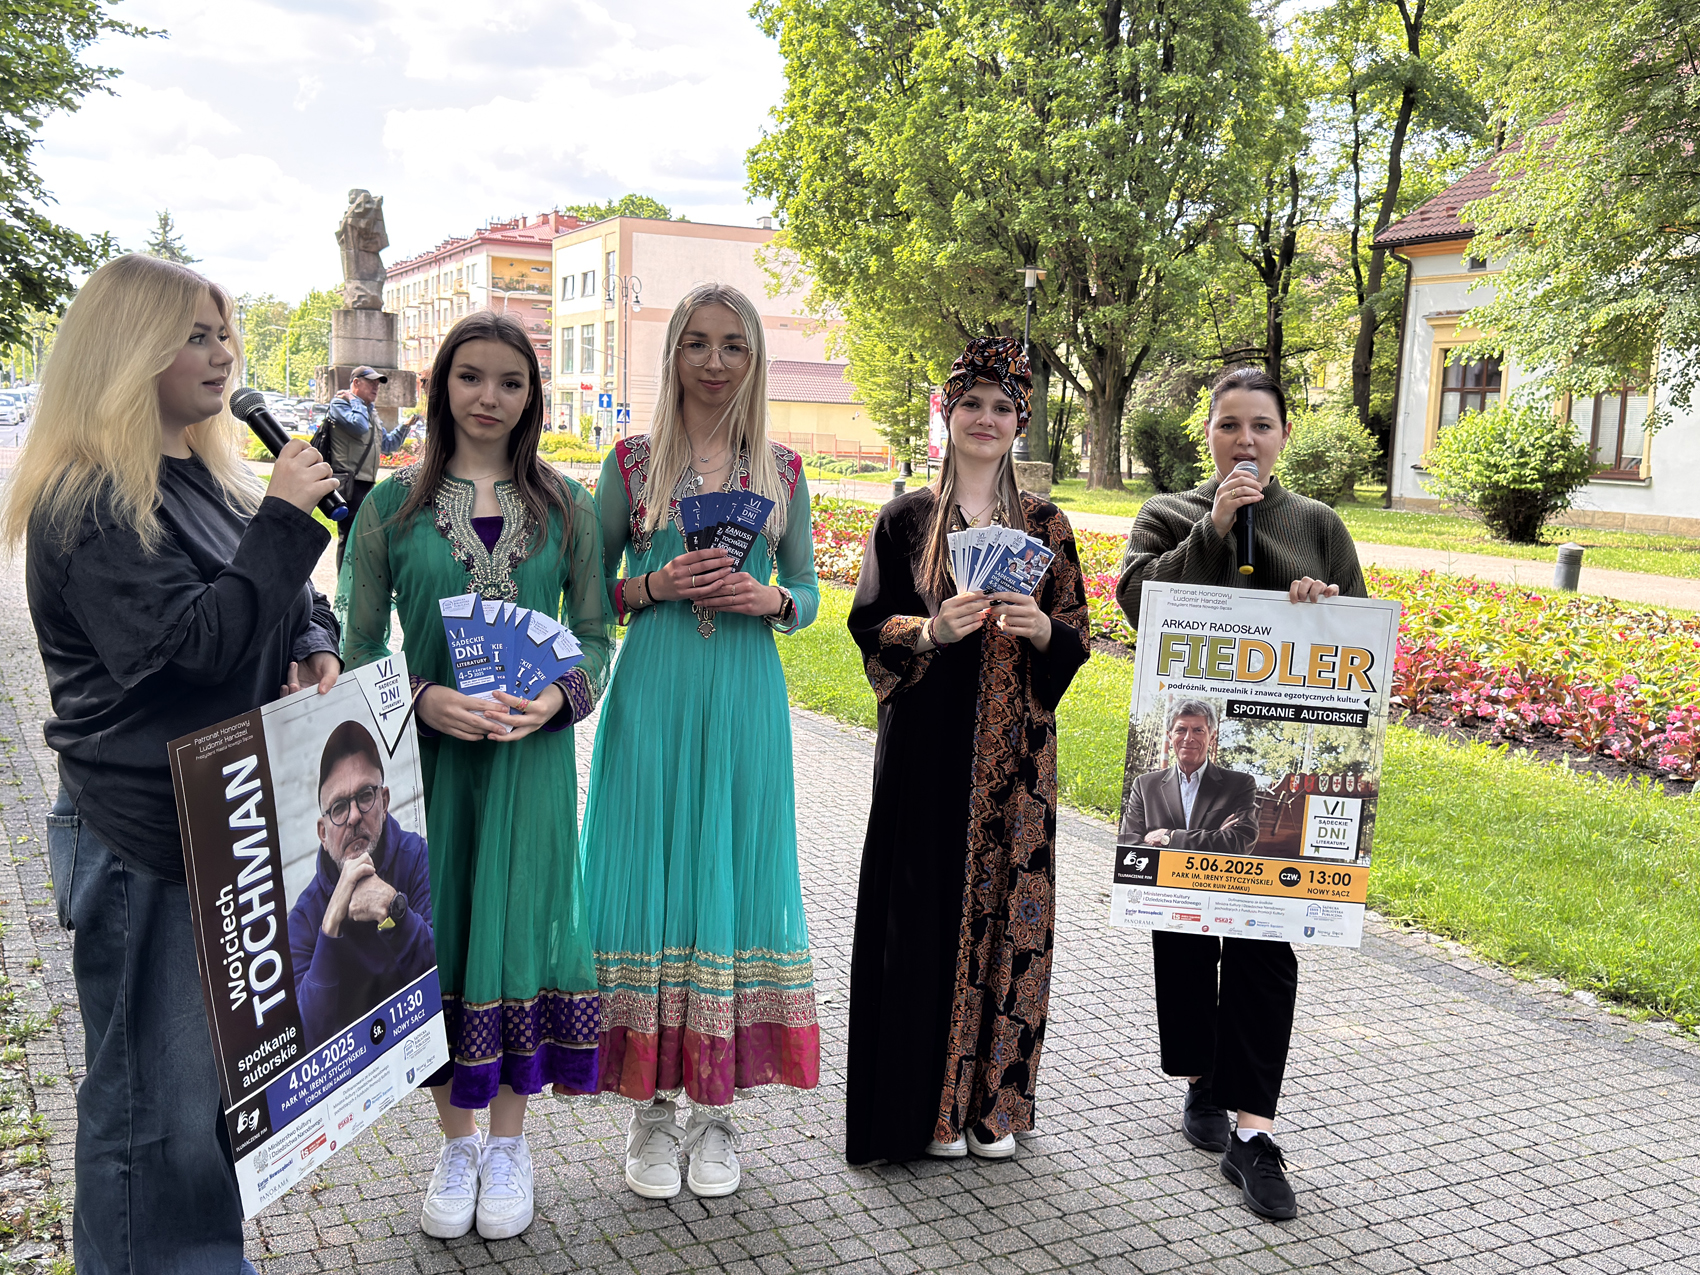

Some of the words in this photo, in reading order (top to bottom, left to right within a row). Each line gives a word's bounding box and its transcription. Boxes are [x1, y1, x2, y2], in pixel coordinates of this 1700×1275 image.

[750, 498, 762, 509] VI
[742, 509, 757, 520] DNI
[721, 535, 748, 549] TOCHMAN
[726, 525, 753, 541] ZANUSSI
[717, 543, 744, 557] MORENO
[1169, 588, 1197, 596] Patronat
[1198, 591, 1233, 600] Honorowy
[1173, 595, 1199, 603] Ludomir
[1200, 598, 1228, 606] Handzel
[449, 627, 465, 639] VI
[1161, 618, 1208, 631] ARKADY
[1209, 622, 1272, 636] RADOSŁAW
[451, 635, 485, 648] SĄDECKIE
[455, 643, 484, 659] DNI
[376, 659, 393, 678] VI
[456, 657, 487, 668] LITERATURY
[1156, 631, 1377, 693] FIEDLER
[378, 678, 399, 690] SĄDECKIE
[458, 670, 473, 680] 4-5
[380, 686, 400, 704] DNI
[1167, 682, 1208, 693] podróżnik,
[1209, 686, 1249, 695] muzealnik
[1284, 692, 1335, 703] egzotycznych
[1336, 695, 1360, 704] kultur
[381, 699, 402, 711] LITERATURY
[1232, 703, 1296, 719] SPOTKANIE
[1300, 709, 1364, 724] AUTORSKIE
[193, 731, 219, 746] Patronat
[220, 720, 251, 736] Honorowy
[199, 738, 223, 753] Ludomir
[223, 728, 248, 743] Handzel
[1323, 799, 1346, 817] VI
[1318, 819, 1349, 827] SĄDECKIE
[1317, 826, 1347, 840] DNI
[1185, 857, 1264, 876] 5.06.2025
[1171, 871, 1190, 879] PARK
[1203, 874, 1225, 882] IRENY
[1225, 876, 1274, 887] STYCZYŃSKIEJ
[1280, 872, 1300, 881] CZW.
[1308, 870, 1352, 887] 13:00
[222, 754, 286, 1028] TOCHMAN
[1192, 881, 1211, 889] (OBOK
[1227, 884, 1251, 892] ZAMKU)
[1307, 887, 1330, 896] NOWY
[1331, 889, 1350, 898] SĄCZ
[216, 884, 247, 1012] Wojciech
[389, 989, 423, 1024] 11:30
[393, 1020, 410, 1037] NOWY
[411, 1009, 426, 1024] SĄCZ
[238, 1026, 297, 1072] spotkanie
[242, 1043, 297, 1088] autorskie
[289, 1032, 355, 1090] 4.06.2025
[281, 1095, 298, 1112] PARK
[299, 1088, 310, 1099] IM.
[309, 1074, 327, 1091] IRENY
[328, 1045, 367, 1079] STYCZYŃSKIEJ
[305, 1090, 322, 1106] (OBOK
[322, 1081, 334, 1092] RUIN
[334, 1068, 352, 1084] ZAMKU)
[267, 1130, 296, 1152] Ministerstwo
[296, 1118, 312, 1132] Kultury
[271, 1137, 297, 1159] Dziedzictwa
[297, 1117, 323, 1140] Narodowego
[259, 1178, 289, 1203] PANORAMA
